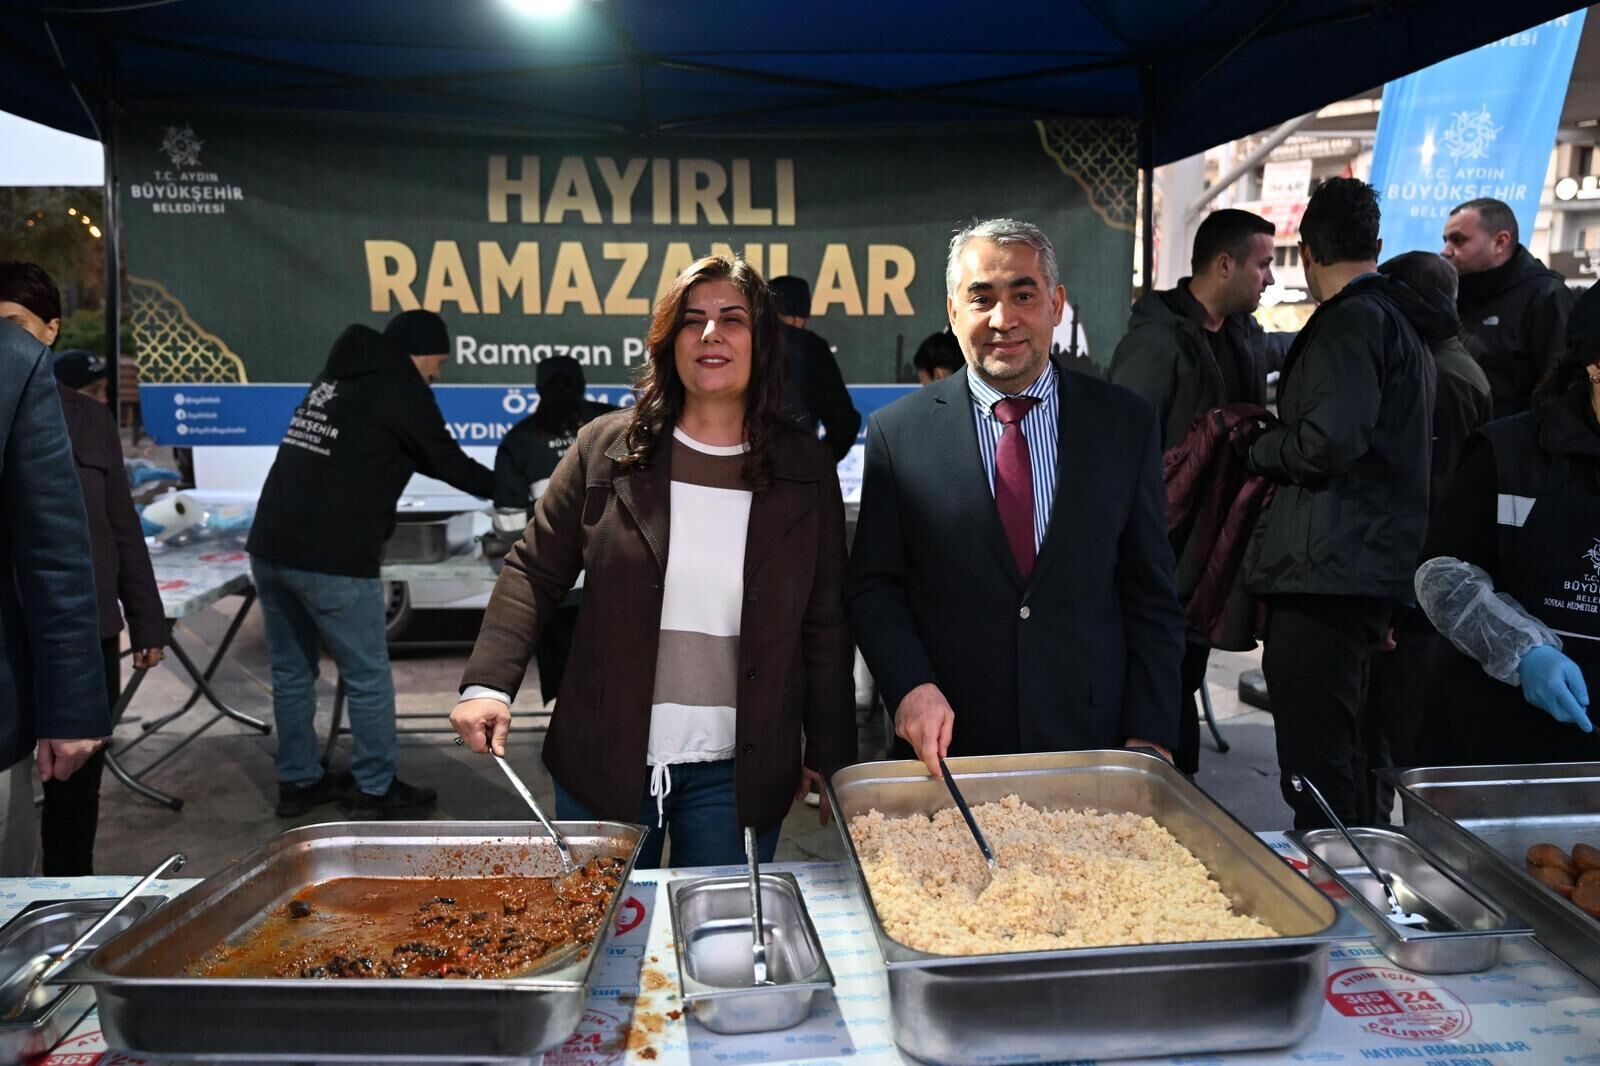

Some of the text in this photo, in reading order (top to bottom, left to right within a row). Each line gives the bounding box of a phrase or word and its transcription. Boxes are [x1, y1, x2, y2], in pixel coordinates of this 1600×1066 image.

[180, 172, 218, 183] AYDIN
[1456, 167, 1505, 180] AYDIN
[130, 182, 244, 202] BÜYÜKŞEHİR
[487, 155, 796, 226] HAYIRLI
[152, 202, 225, 214] BELEDİYESİ
[1340, 972, 1378, 988] AYDIN
[1341, 990, 1436, 1004] 365 24
[1406, 1004, 1445, 1012] SAAT
[1359, 1047, 1424, 1060] HAYIRLI
[1422, 1041, 1532, 1057] RAMAZANLAR
